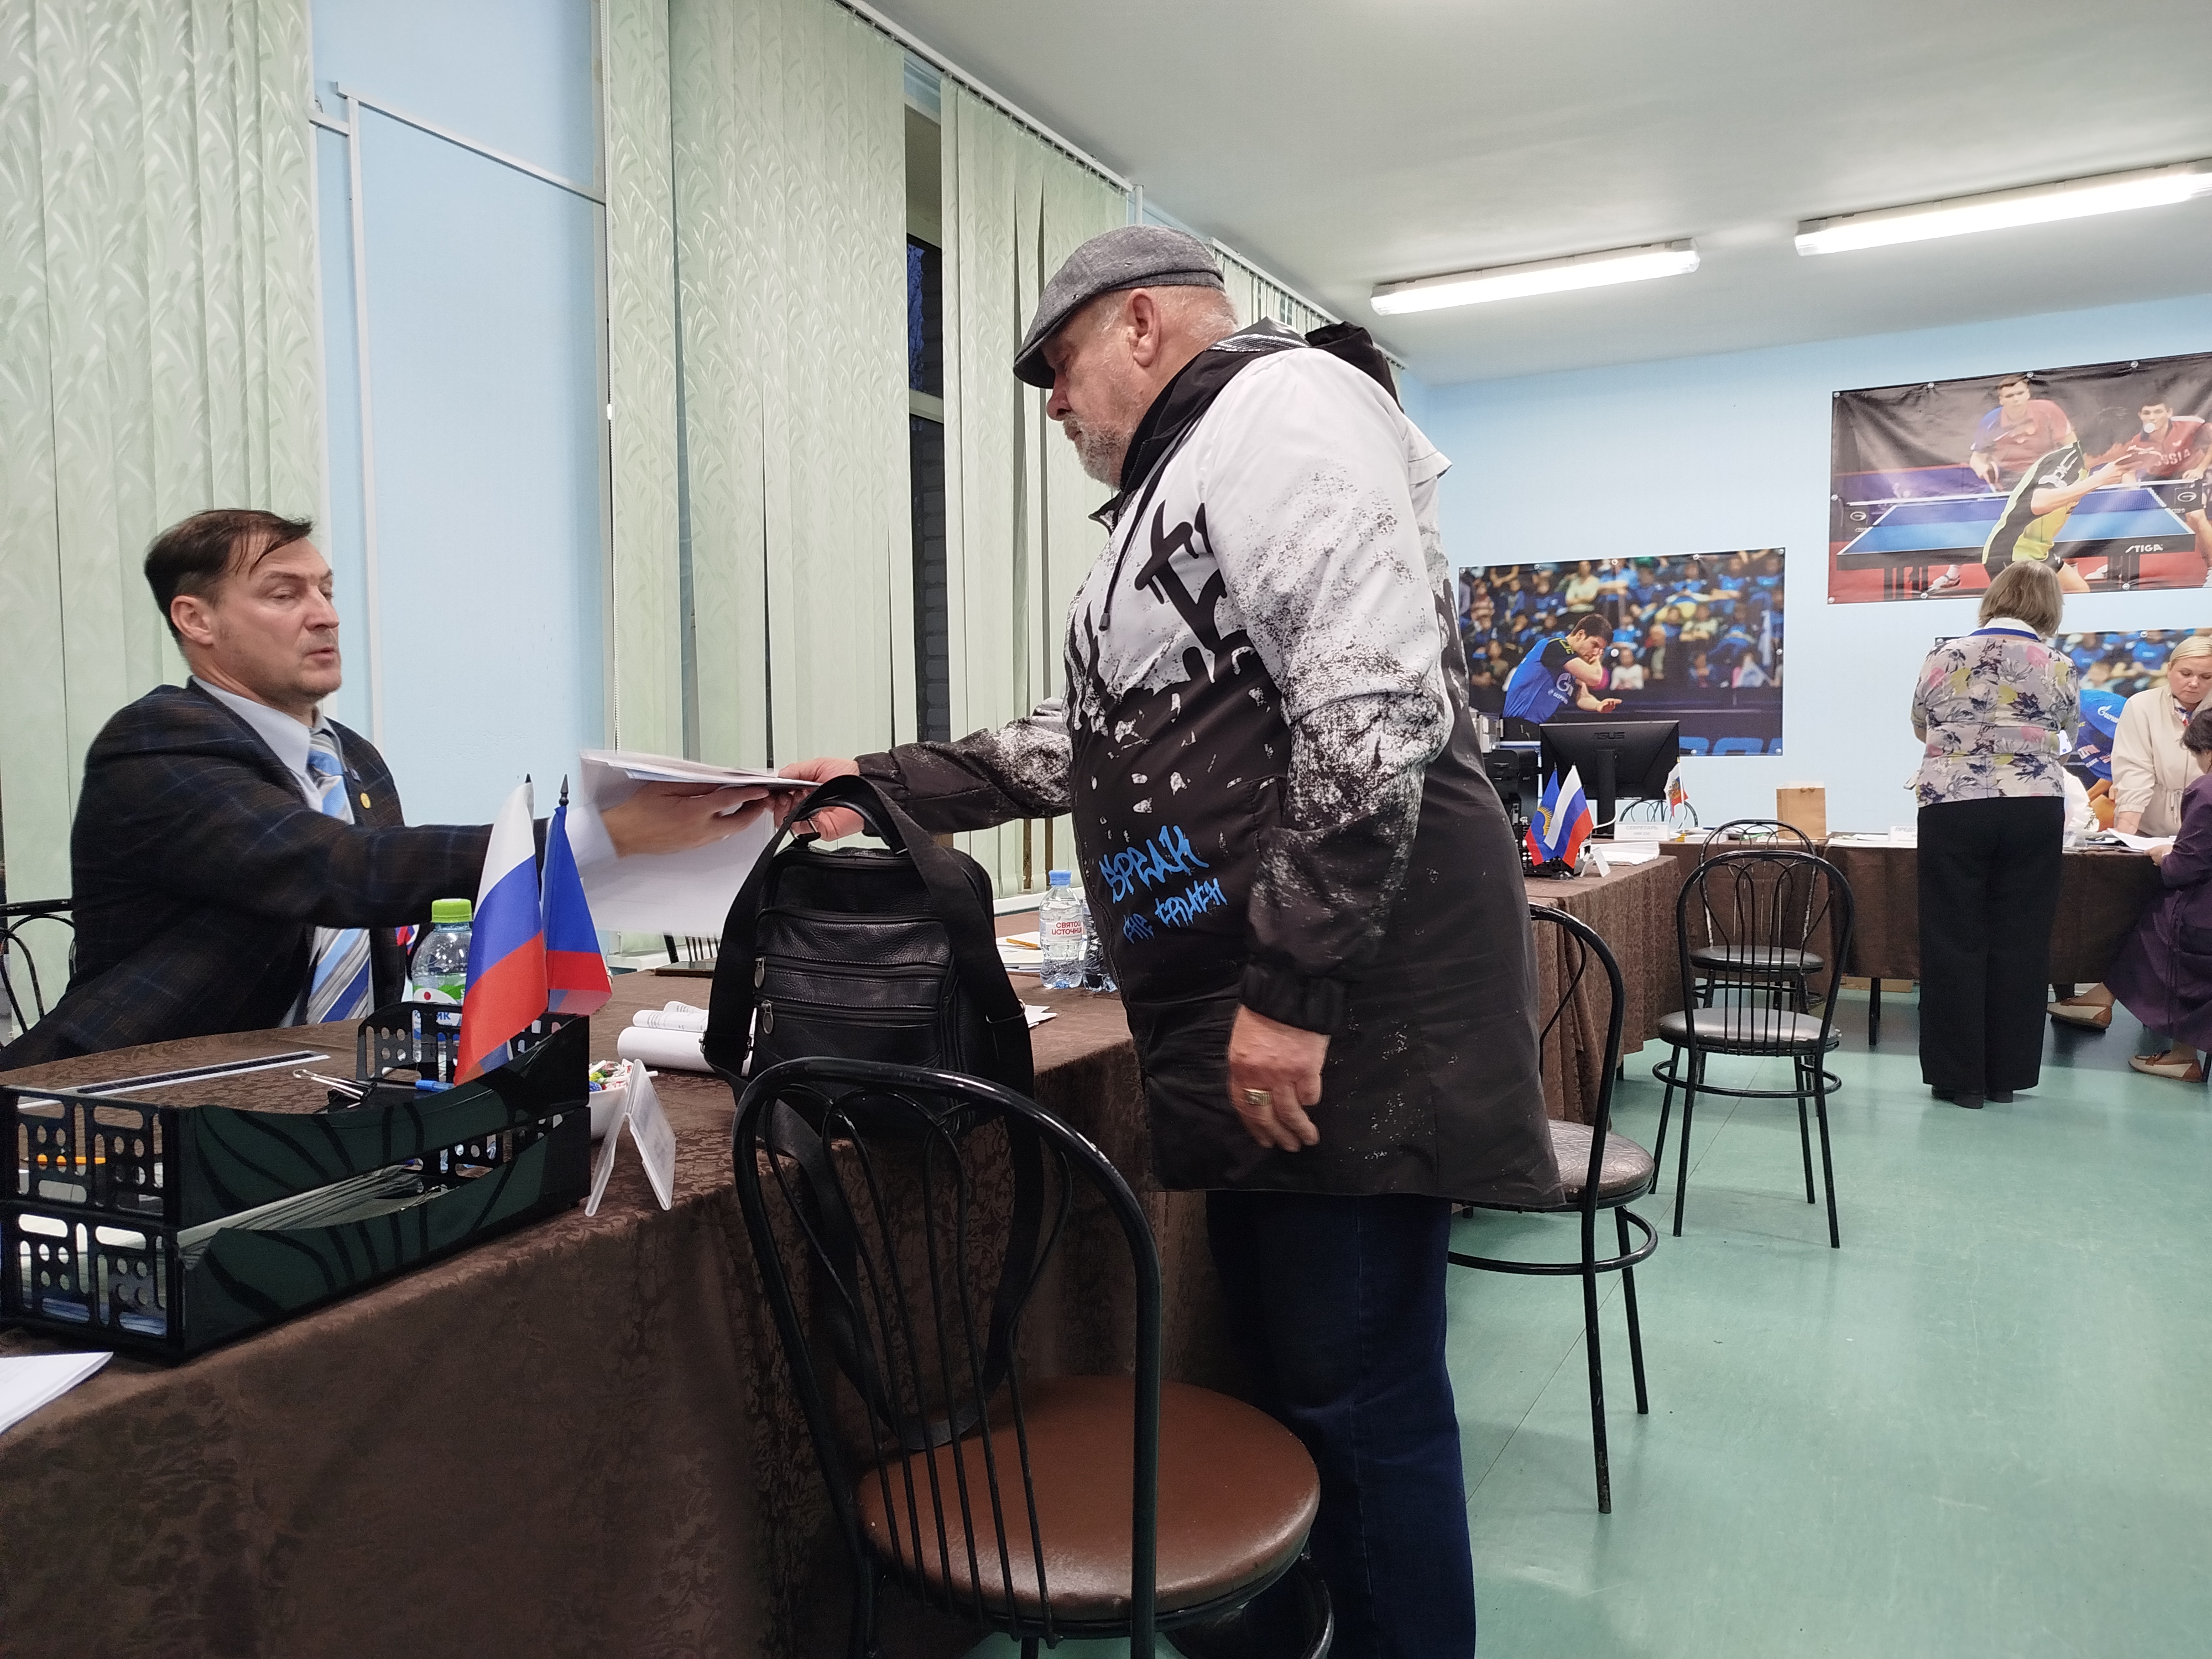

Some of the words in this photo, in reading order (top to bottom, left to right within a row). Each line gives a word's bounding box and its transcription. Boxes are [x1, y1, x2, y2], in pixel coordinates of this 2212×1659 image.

[2125, 544, 2163, 553] STIGA
[1593, 732, 1625, 740] ASUS
[1099, 826, 1209, 904] SPEAK
[1051, 927, 1082, 935] ИСТОЧНИ
